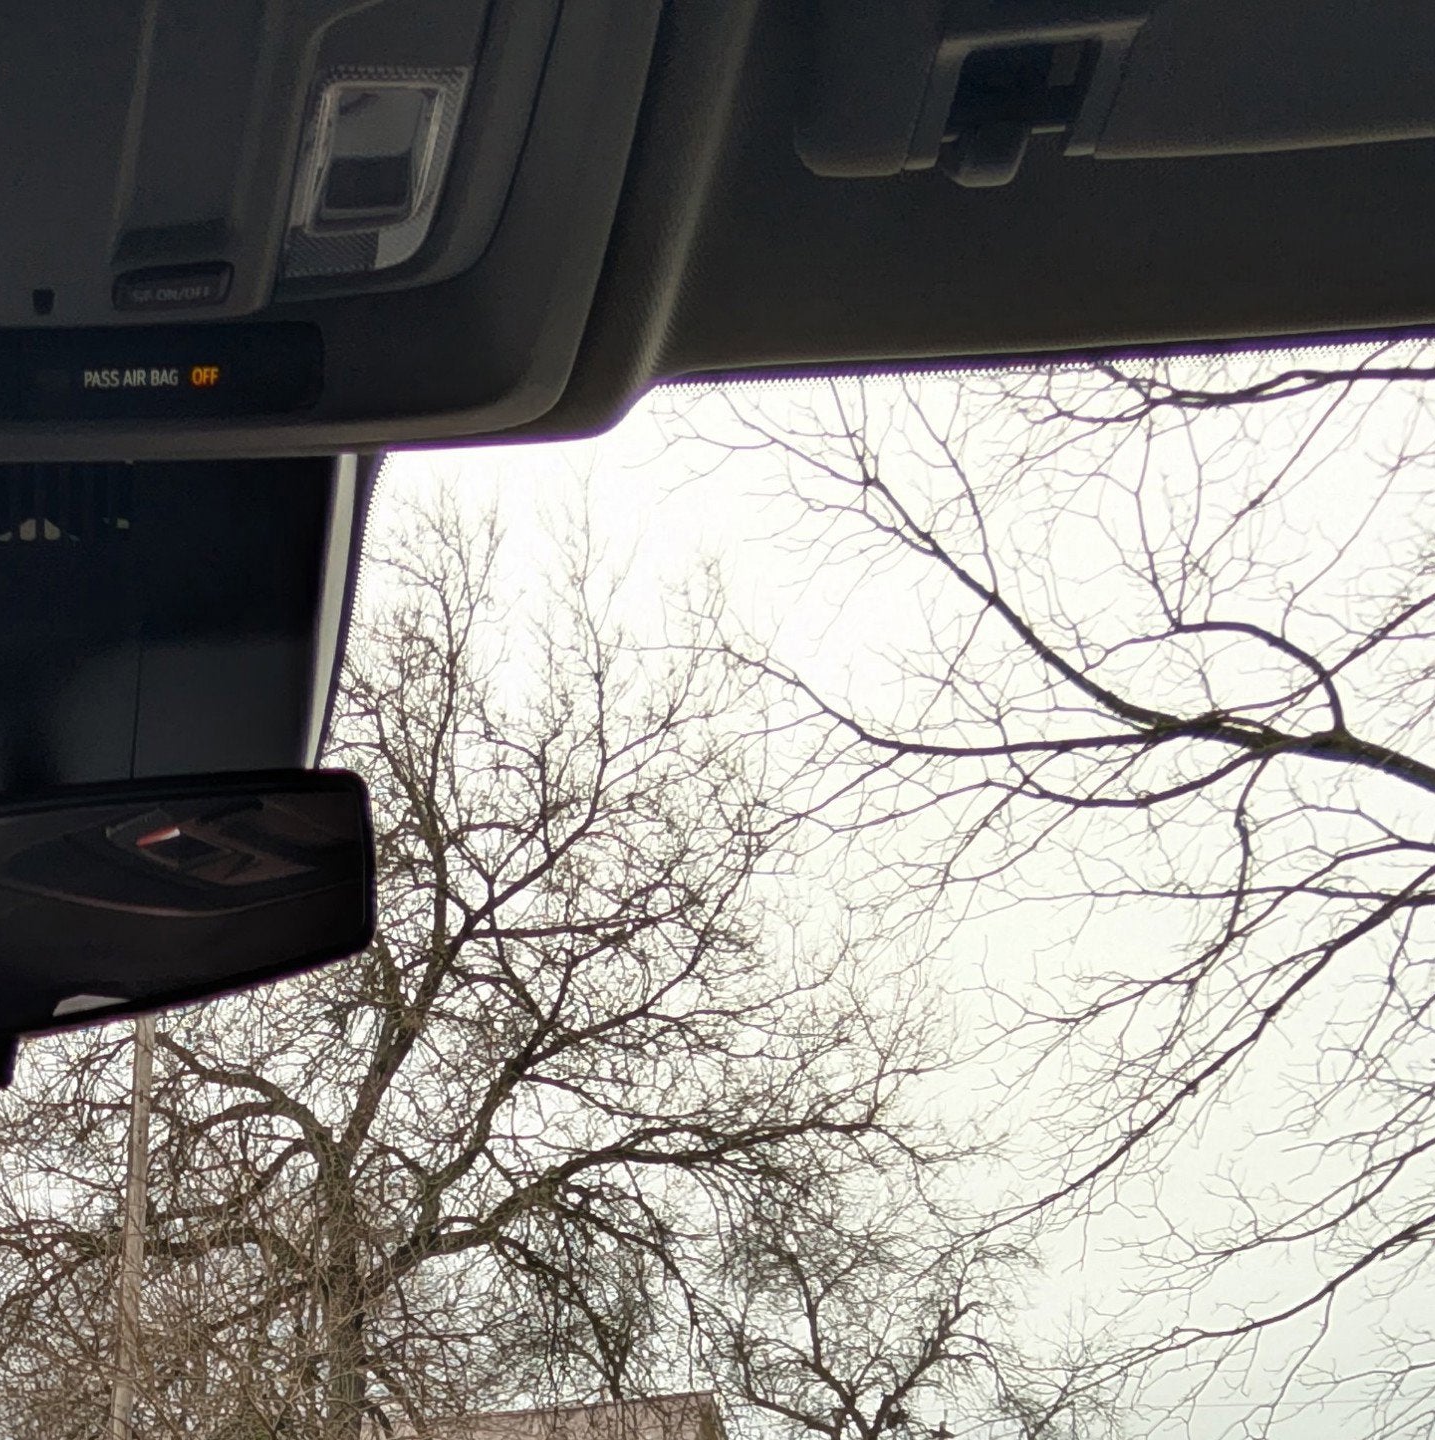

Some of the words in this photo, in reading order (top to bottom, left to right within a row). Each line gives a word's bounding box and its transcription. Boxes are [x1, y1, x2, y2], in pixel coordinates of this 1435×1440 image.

[83, 370, 119, 388] PASS
[122, 370, 146, 387] AIR
[150, 369, 179, 386] BAG
[190, 368, 219, 386] OFF
